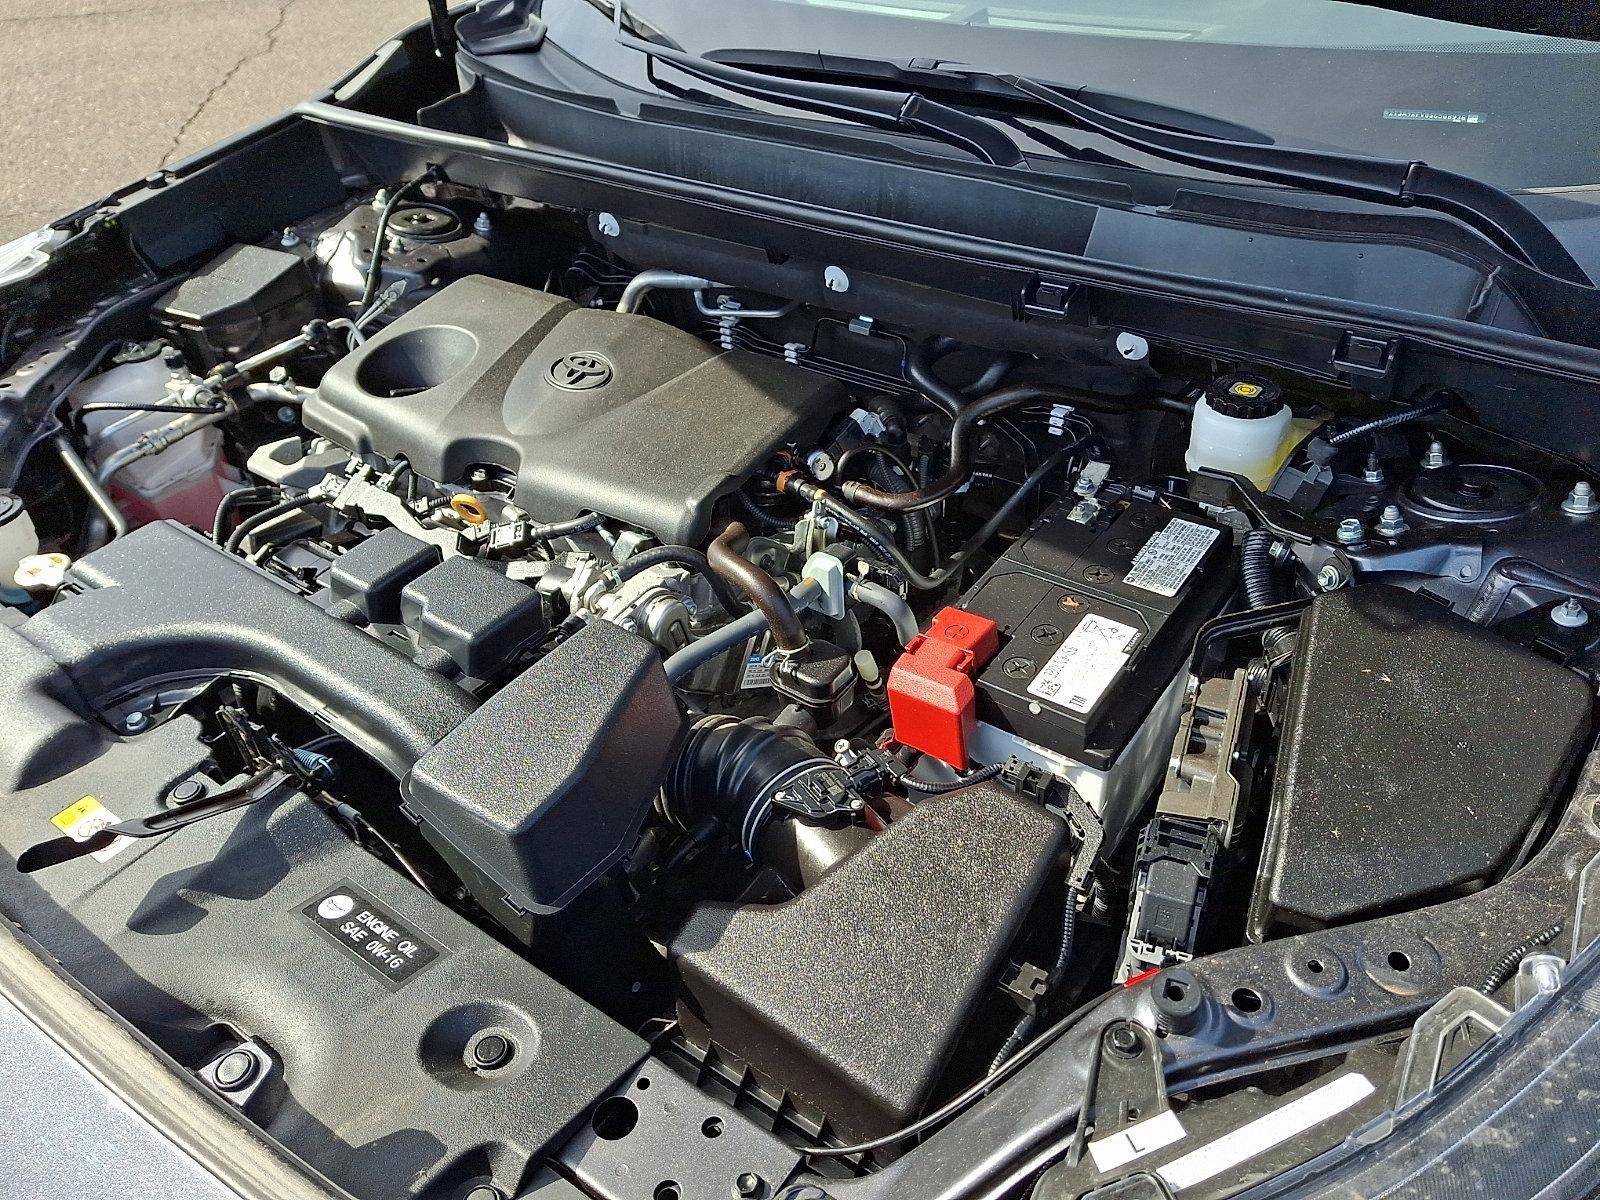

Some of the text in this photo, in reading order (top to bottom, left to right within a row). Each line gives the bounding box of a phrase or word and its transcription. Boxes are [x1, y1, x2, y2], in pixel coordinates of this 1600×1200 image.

[340, 921, 404, 969] SAE 0W-16
[356, 910, 418, 959] ENGINE OIL
[1125, 1133, 1146, 1154] L
